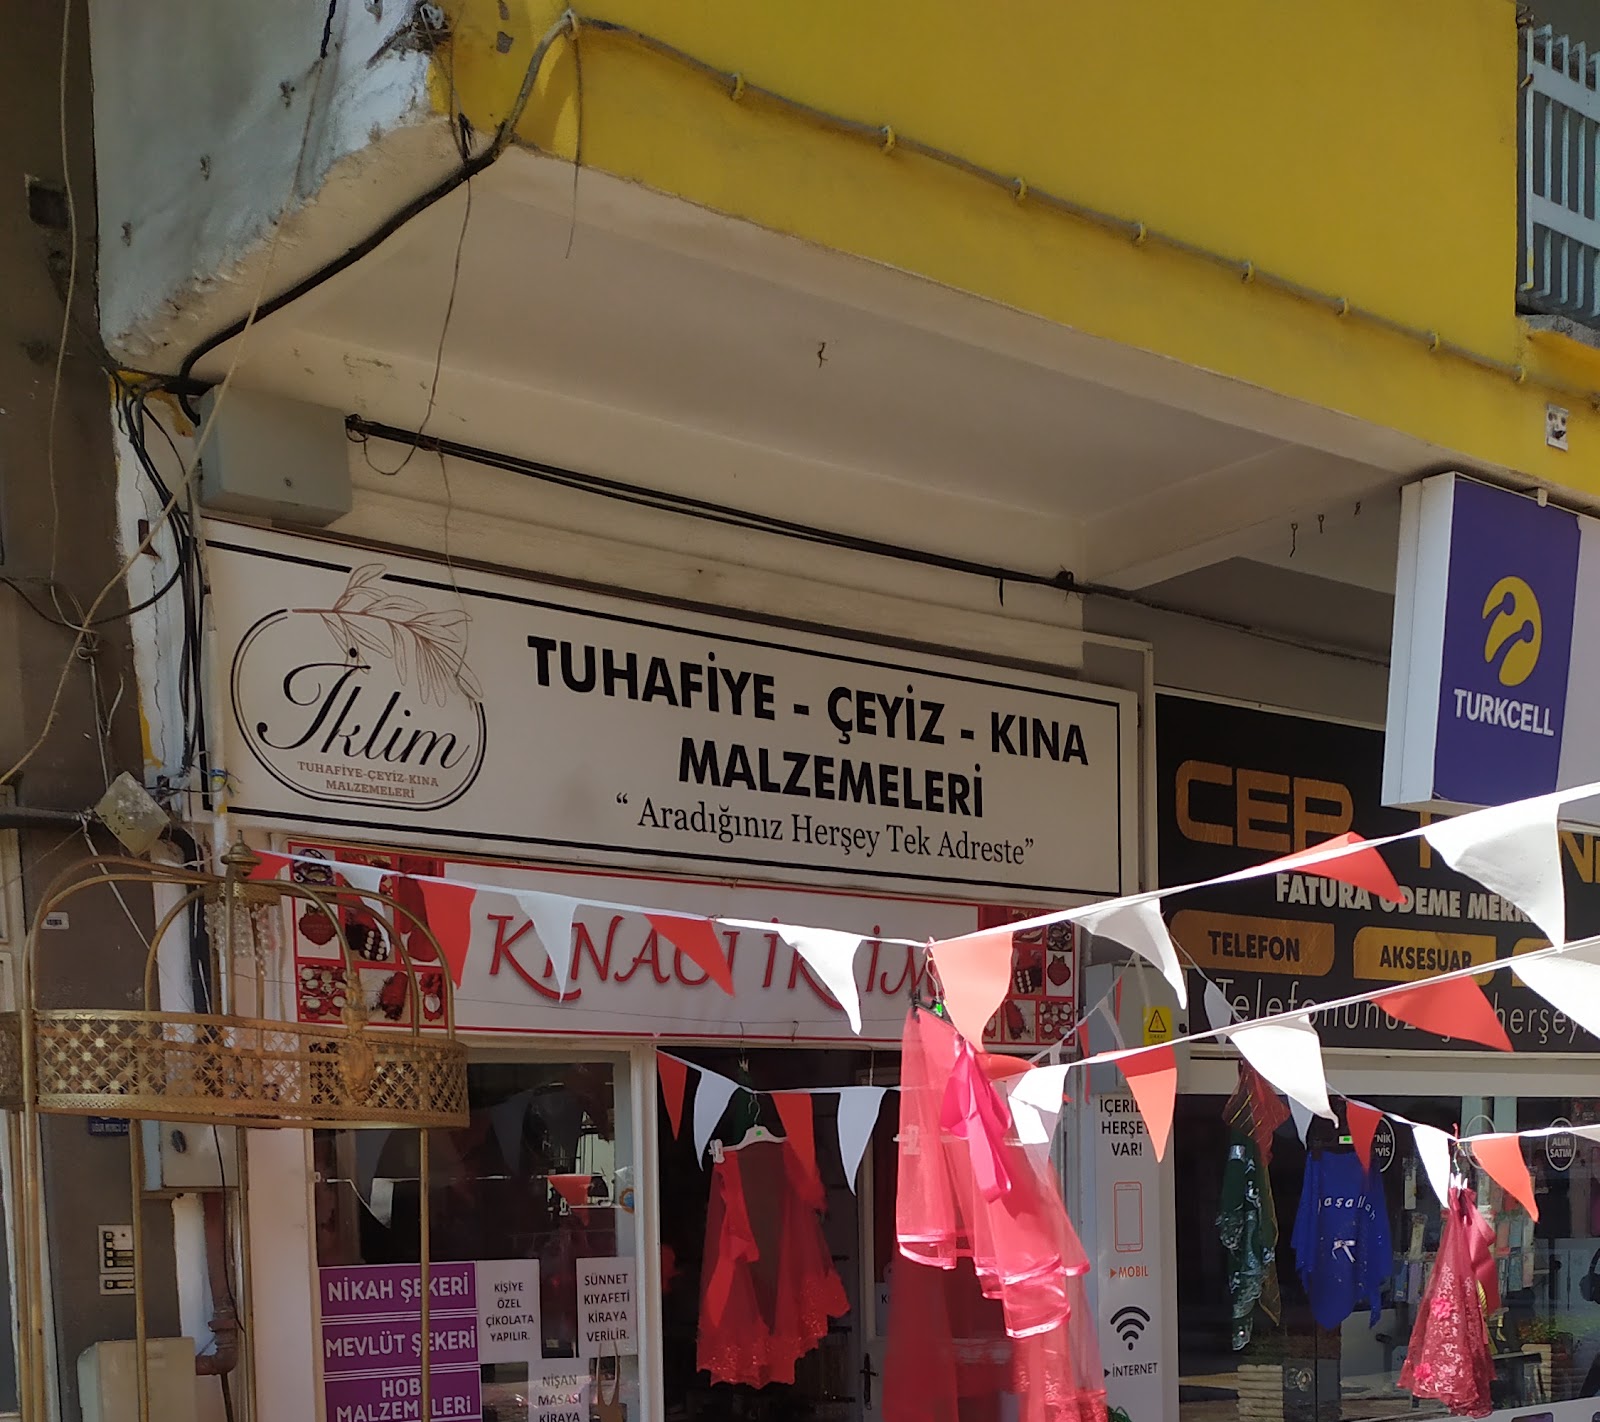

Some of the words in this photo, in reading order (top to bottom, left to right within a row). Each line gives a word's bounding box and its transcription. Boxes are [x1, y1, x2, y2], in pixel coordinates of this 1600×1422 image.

[527, 635, 775, 721] TUHAFİYE
[827, 685, 945, 745] ÇEYİZ
[991, 711, 1088, 766] KINA
[1453, 688, 1555, 737] TURKCELL
[679, 737, 983, 818] MALZEMELERİ
[326, 779, 415, 799] MALZEMELERİ
[1175, 760, 1354, 854] CEP
[638, 798, 783, 843] Aradığınız
[792, 815, 880, 858] Herşey
[887, 826, 930, 858] Tek
[1276, 873, 1371, 910] FATURA
[1208, 930, 1300, 962] TELEFON
[1380, 945, 1472, 971] AKSESUAR
[1111, 1142, 1142, 1156] VAR!
[1550, 1149, 1572, 1158] SATIM
[328, 1277, 393, 1301] NİKAH
[584, 1273, 628, 1286] SÜNNET
[584, 1290, 630, 1305] KIYAFETİ
[486, 1314, 534, 1328] ÇİKOLATA
[588, 1311, 627, 1323] KİRAYA
[325, 1330, 406, 1358] MEVLÜT
[1112, 1362, 1158, 1378] İNTERNET
[382, 1378, 421, 1398] HOB
[542, 1373, 577, 1388] NİŞAN
[538, 1394, 581, 1406] MASASI
